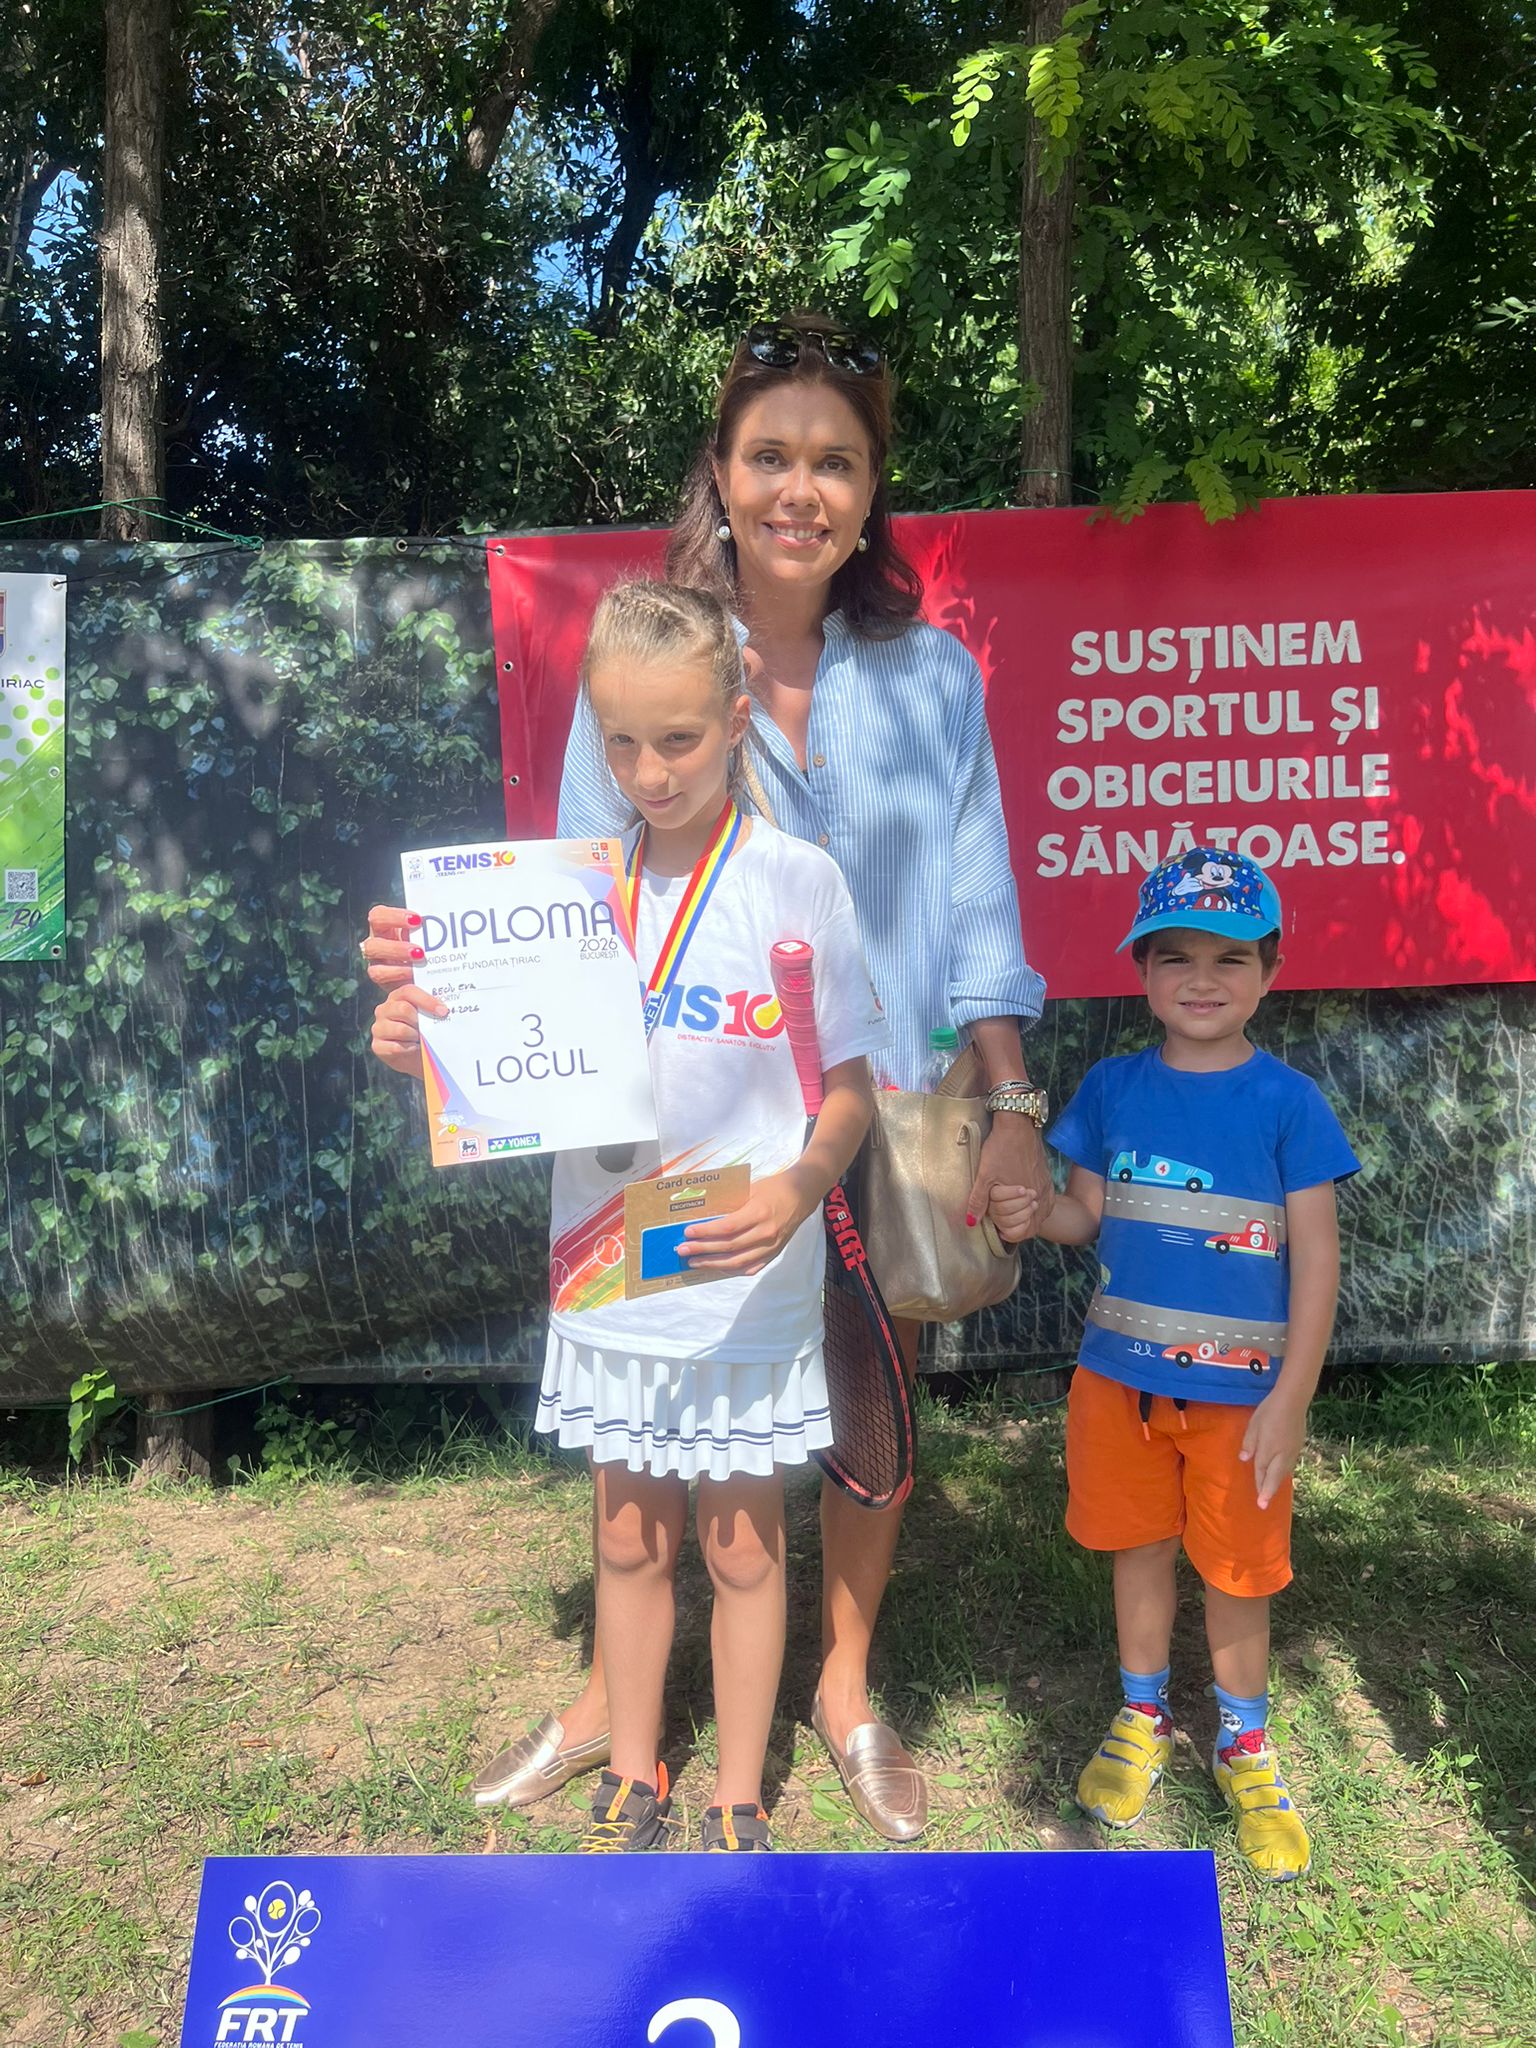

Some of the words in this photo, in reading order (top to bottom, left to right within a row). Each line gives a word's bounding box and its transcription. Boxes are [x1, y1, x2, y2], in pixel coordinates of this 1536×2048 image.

[1070, 620, 1362, 684] SUSȚINEM
[0, 679, 45, 689] IRIAC
[1056, 690, 1314, 744] SPORTUL
[1330, 686, 1379, 745] ȘI
[1047, 753, 1391, 811] OBICEIURILE
[1036, 820, 1406, 878] SĂNĂTOASE.
[0, 908, 42, 930] .RO
[421, 900, 616, 952] DIPLOMA
[579, 938, 618, 951] 2026
[426, 954, 448, 966] KIDS
[449, 952, 467, 961] DAY
[521, 1013, 544, 1048] 3
[677, 1033, 713, 1044] DISTRACTIV
[476, 1048, 598, 1087] LOCUL
[508, 1135, 539, 1149] YONEX
[1159, 1164, 1167, 1173] 4
[656, 1178, 683, 1191] Card
[685, 1173, 720, 1186] cadou
[1253, 1235, 1260, 1246] 5
[1202, 1345, 1209, 1355] 6
[216, 2008, 308, 2042] FRT
